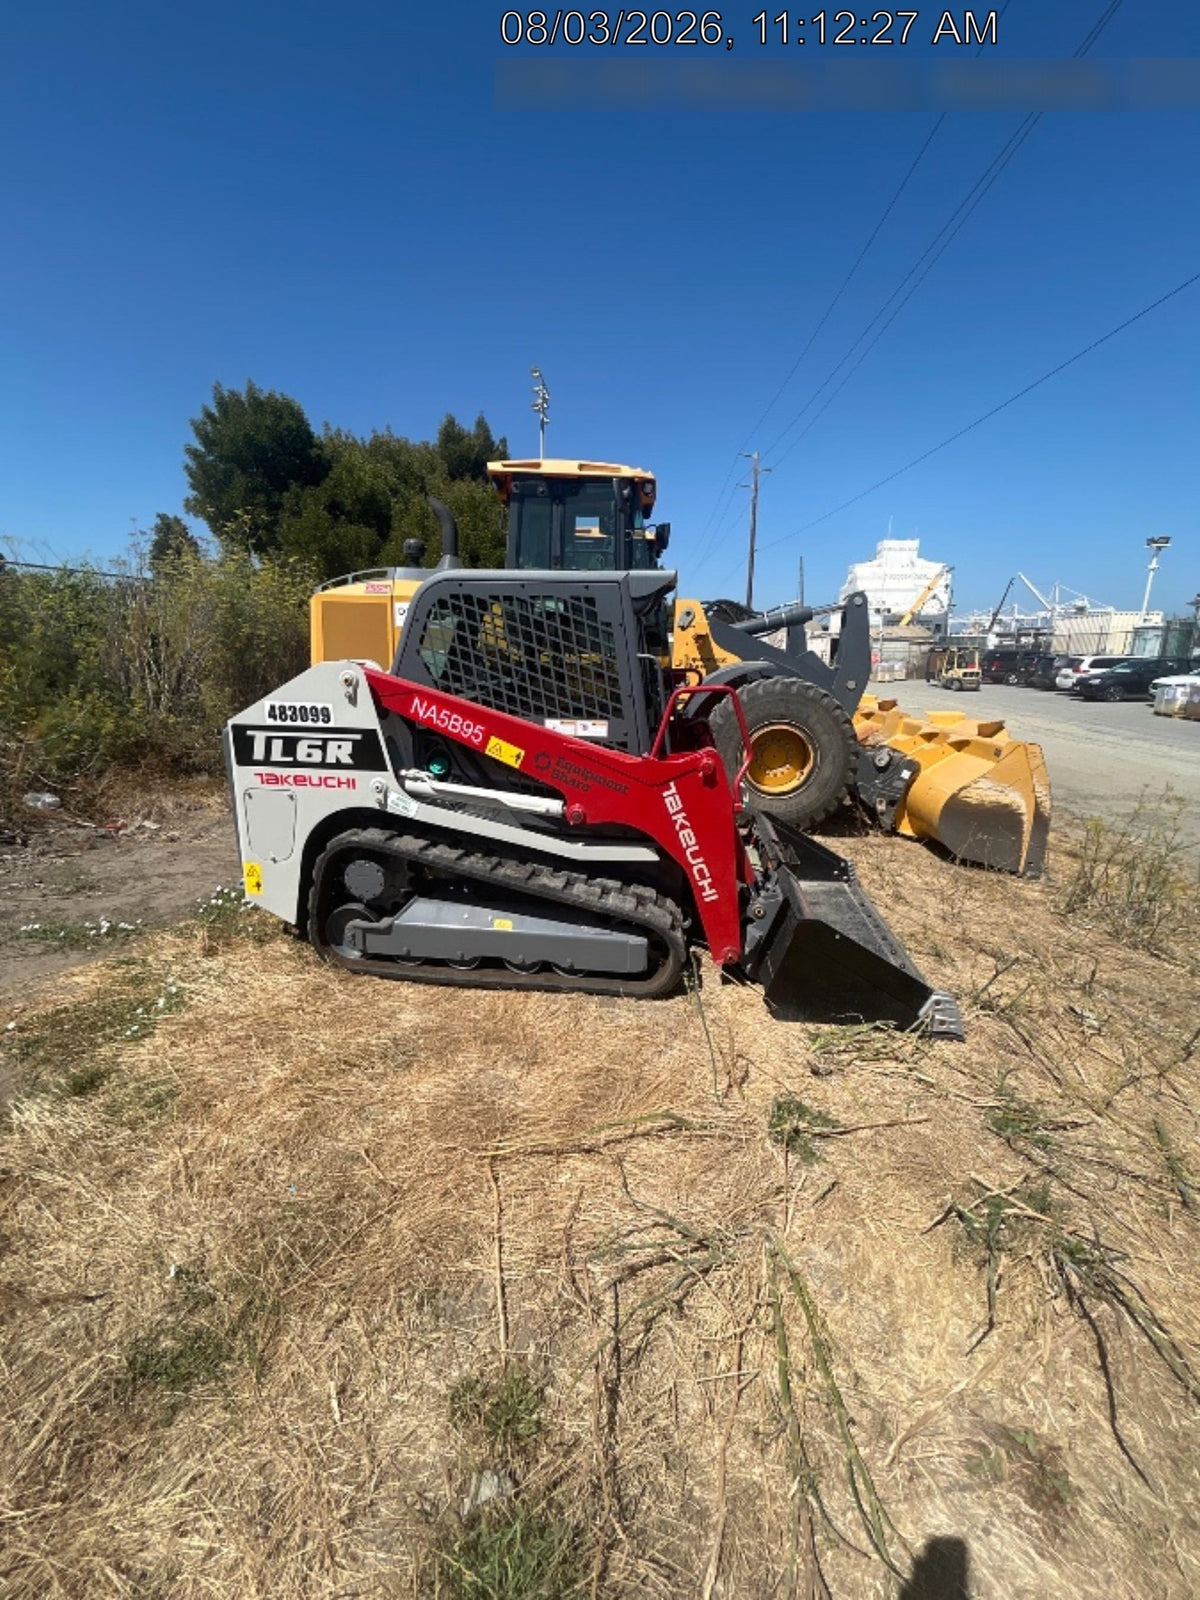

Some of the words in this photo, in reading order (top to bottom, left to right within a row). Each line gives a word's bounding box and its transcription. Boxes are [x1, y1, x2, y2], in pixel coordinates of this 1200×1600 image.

[267, 704, 331, 724] 483099
[410, 697, 484, 743] NA5B95
[246, 730, 362, 765] TL6R
[254, 773, 356, 789] TAKEUCHI
[551, 768, 591, 792] Share
[556, 757, 629, 794] Equipment
[661, 781, 719, 902] TAKEUCHI
